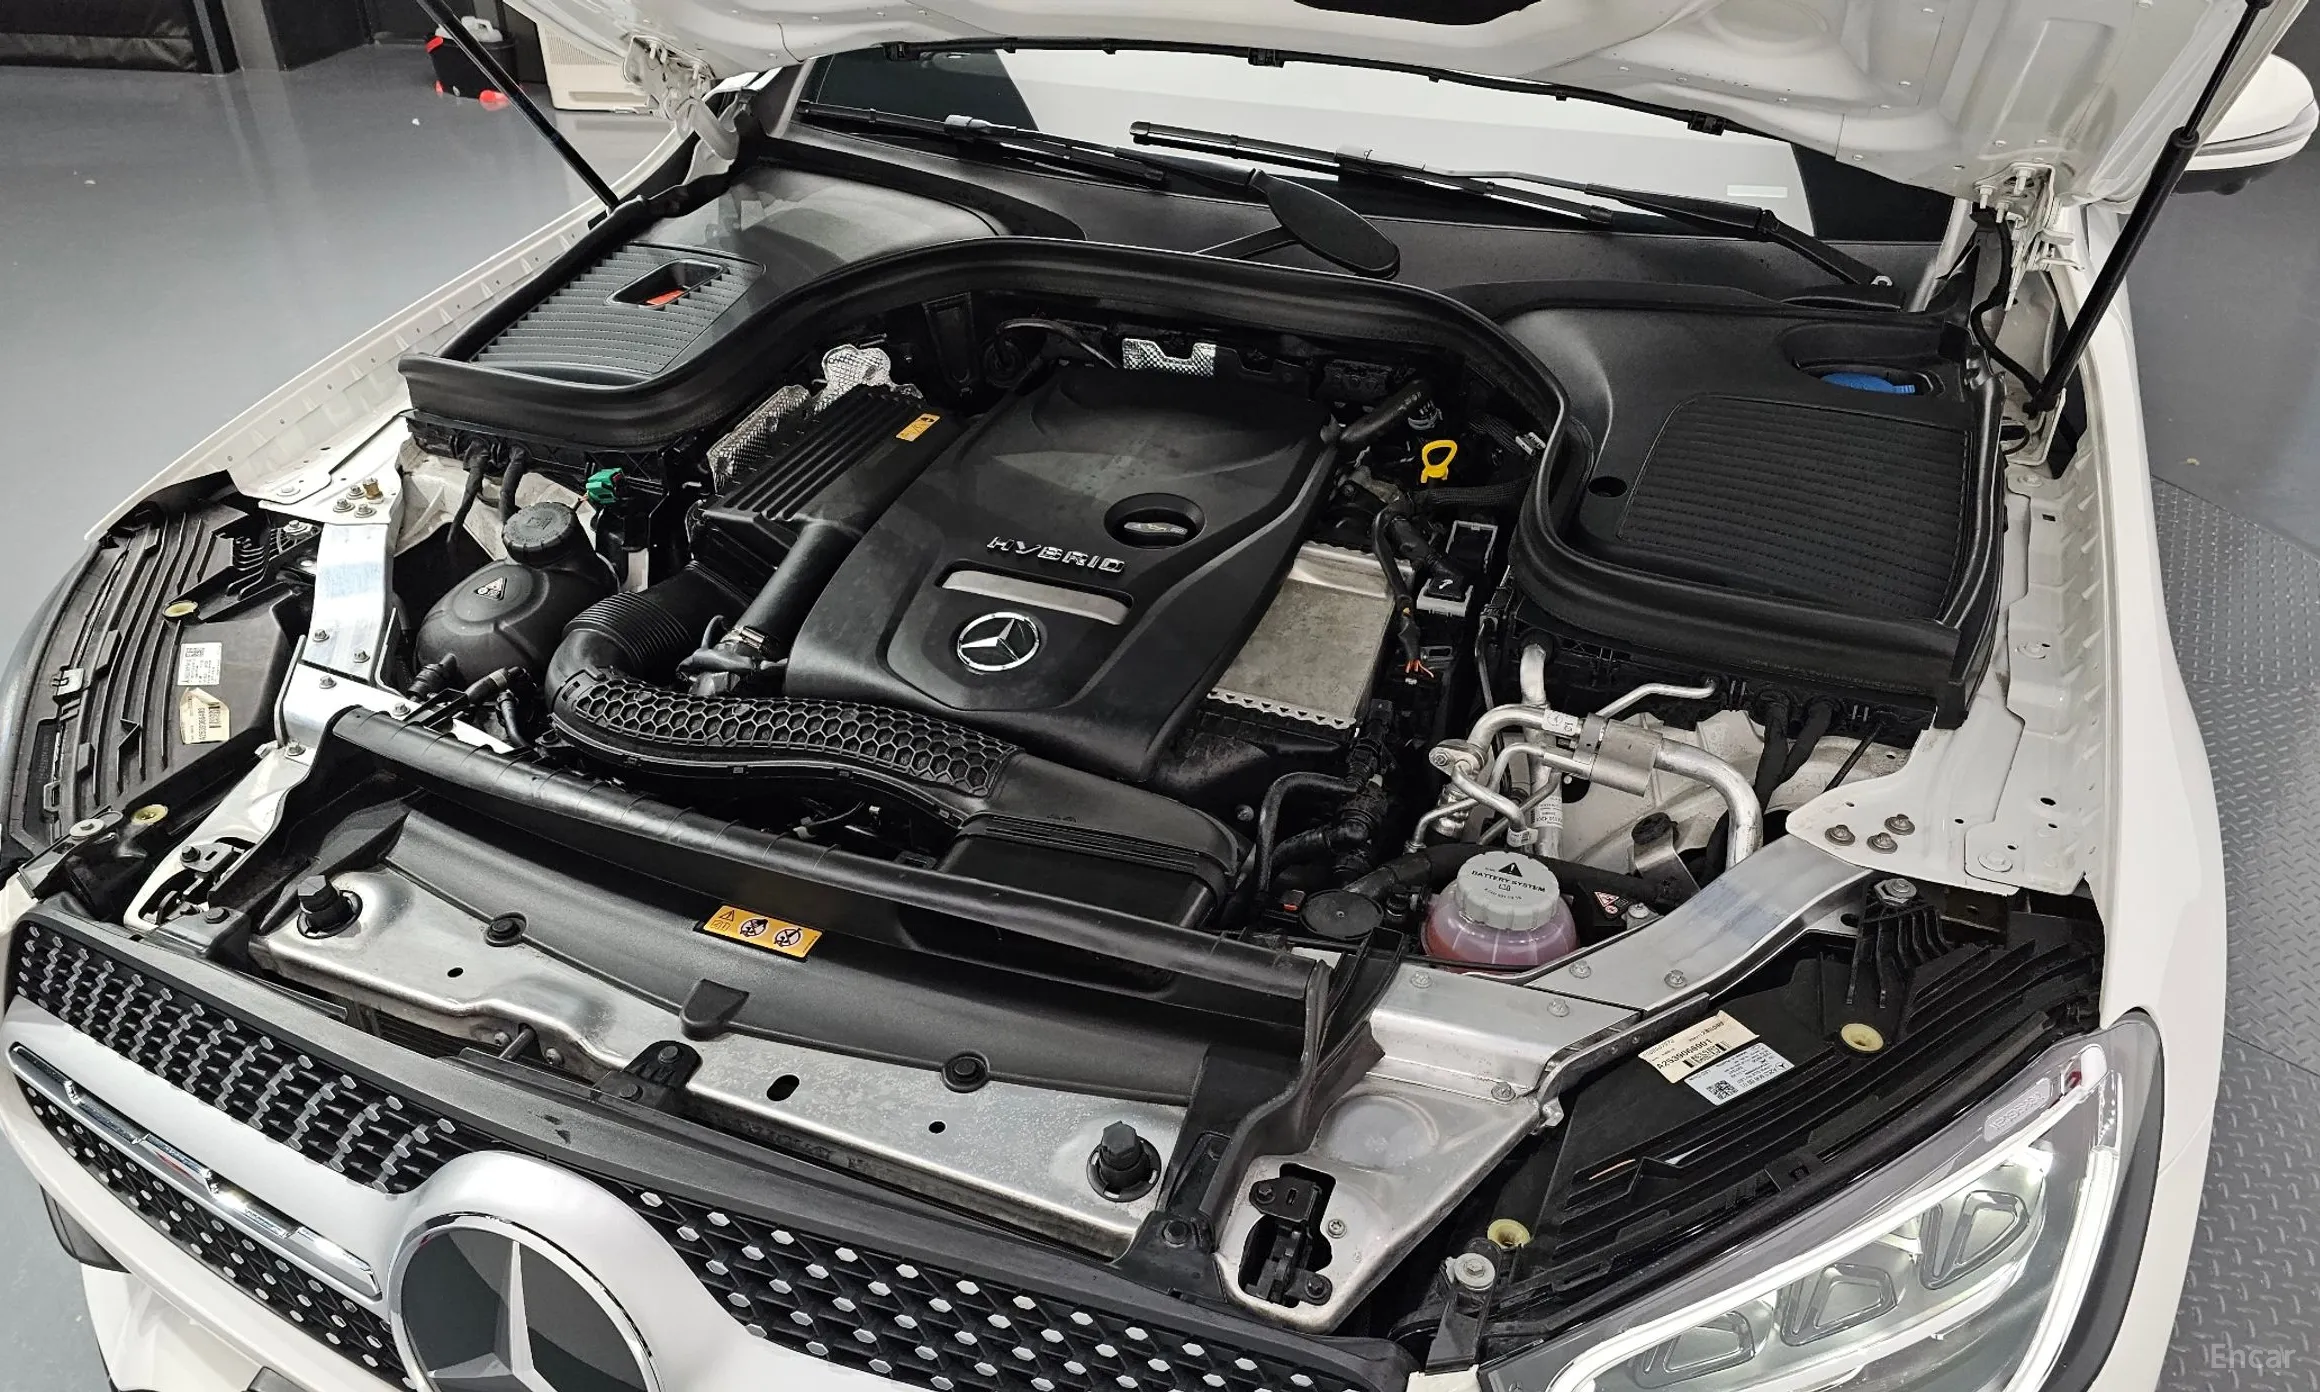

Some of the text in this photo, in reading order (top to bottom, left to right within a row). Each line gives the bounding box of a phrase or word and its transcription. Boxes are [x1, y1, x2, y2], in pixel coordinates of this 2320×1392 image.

[986, 536, 1125, 573] HYBRID
[1471, 870, 1546, 893] BATTERY SYSTEM
